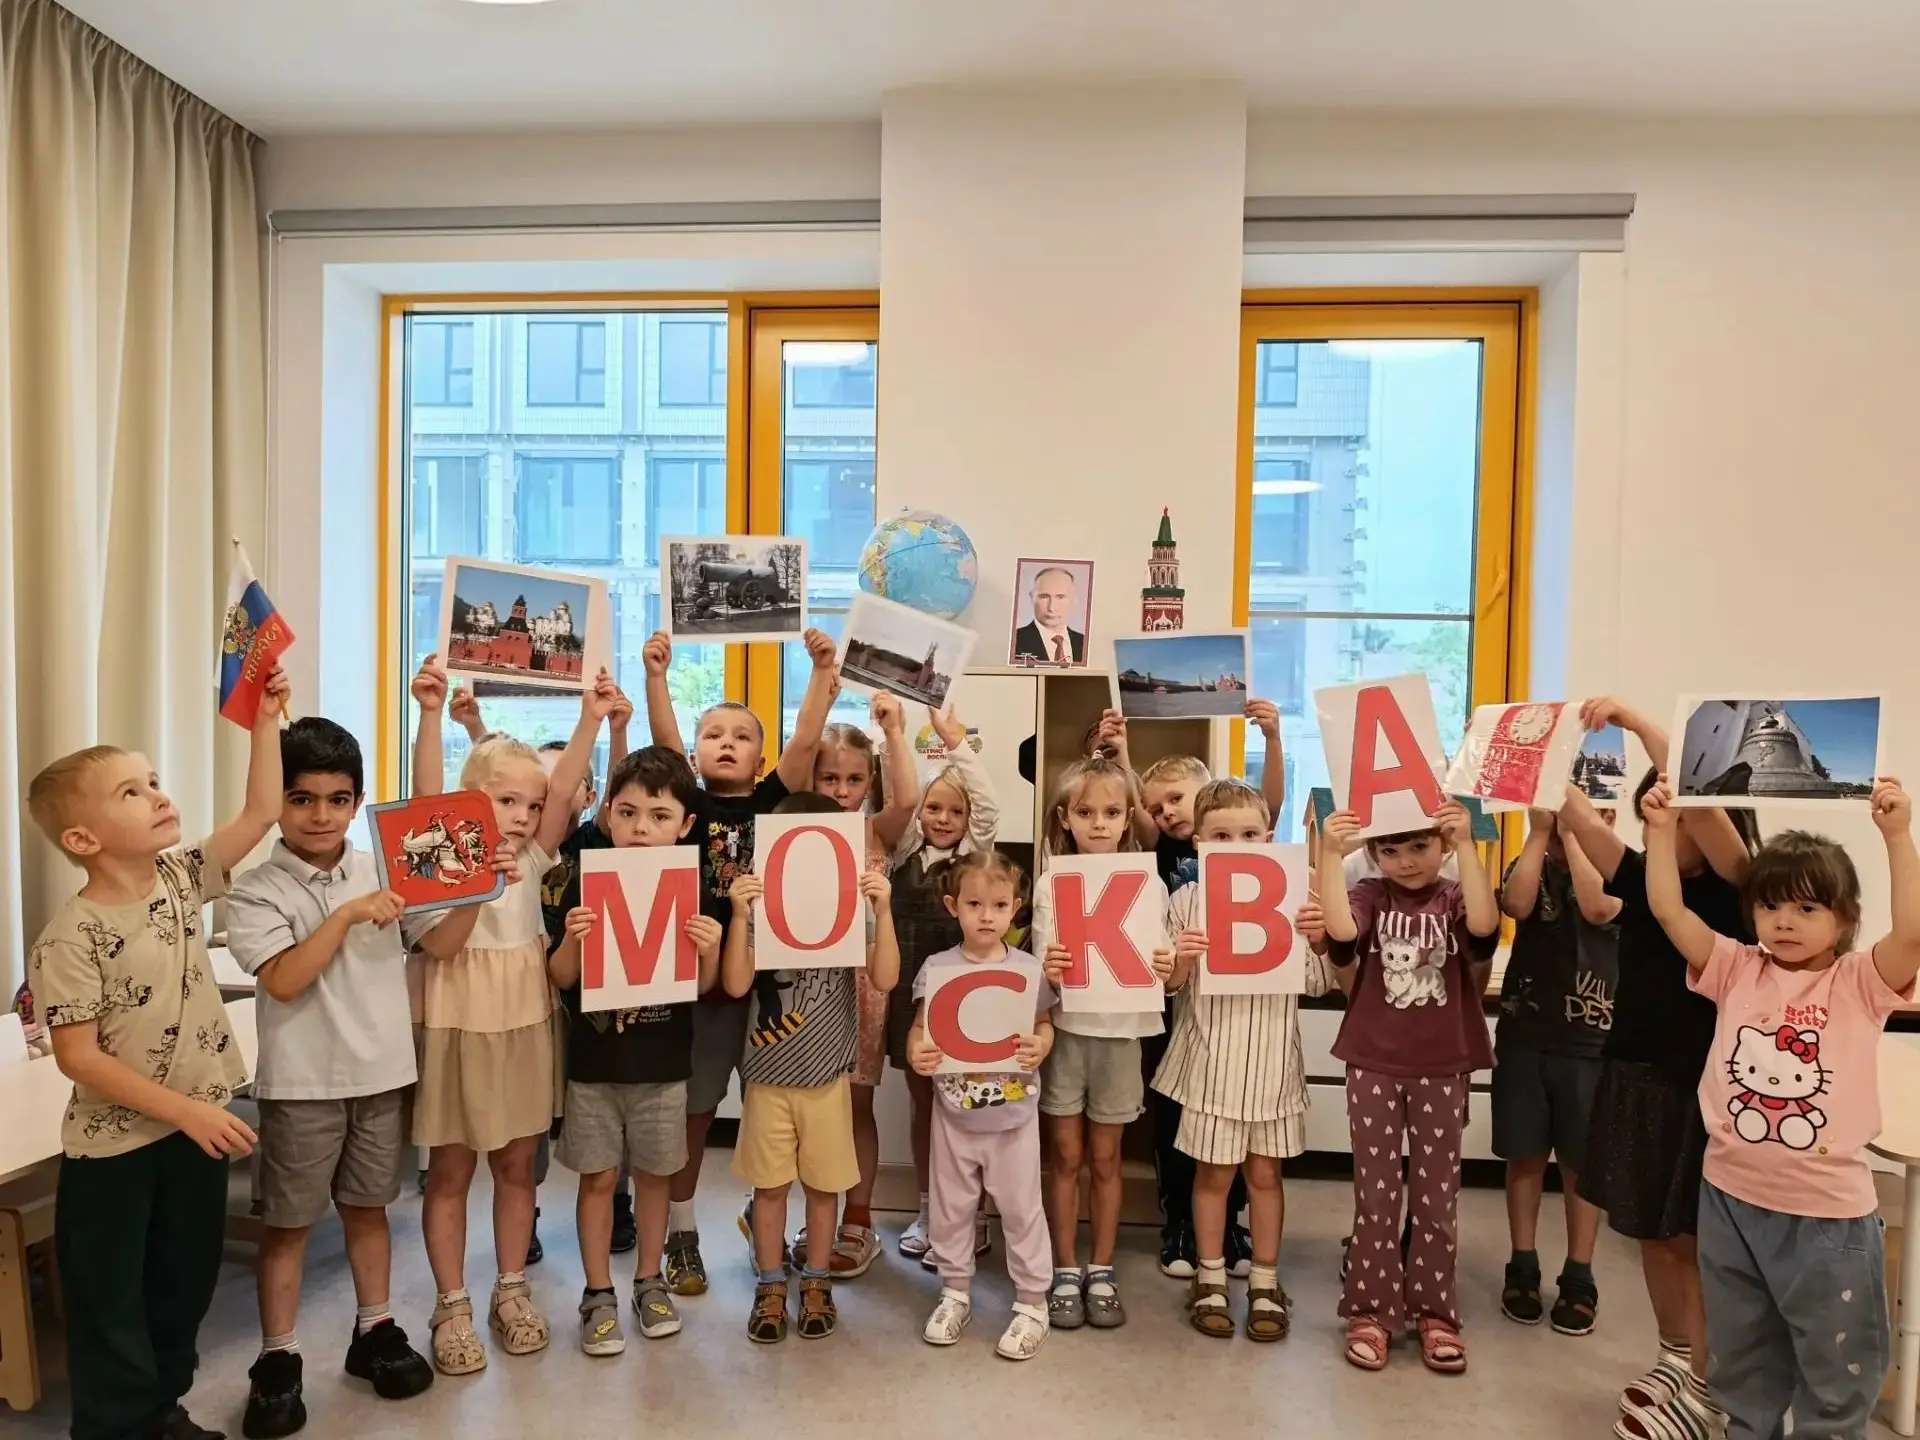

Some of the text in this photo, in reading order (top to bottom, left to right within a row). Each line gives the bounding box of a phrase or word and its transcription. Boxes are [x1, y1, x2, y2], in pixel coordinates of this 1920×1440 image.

[1348, 685, 1447, 828] А
[583, 868, 697, 989] М
[763, 825, 857, 950] О
[1051, 871, 1156, 988] К
[1206, 852, 1293, 974] В
[928, 970, 1026, 1063] С
